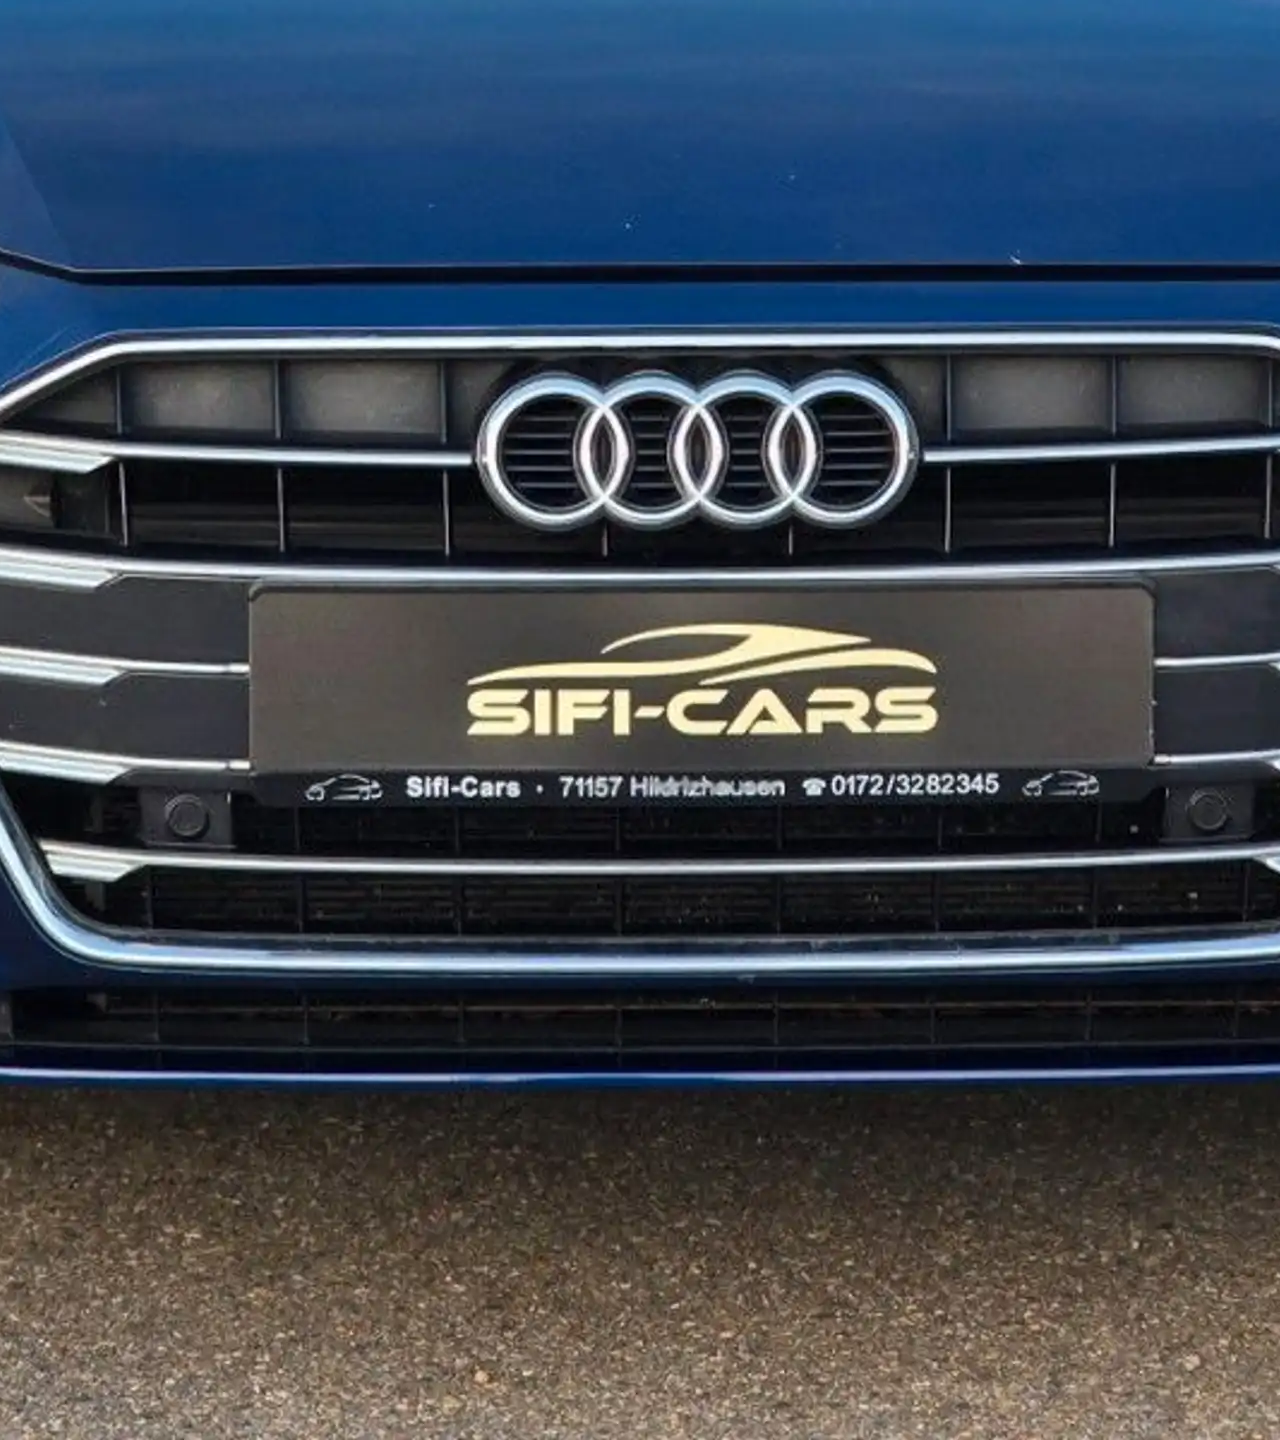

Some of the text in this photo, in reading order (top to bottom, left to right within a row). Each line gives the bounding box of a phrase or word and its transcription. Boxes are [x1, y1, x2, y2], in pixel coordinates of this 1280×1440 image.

[467, 687, 939, 736] SIFI-CARS
[405, 774, 521, 799] Sifi-Cars
[559, 775, 624, 799] 71157
[830, 772, 1000, 797] 0172/3282345
